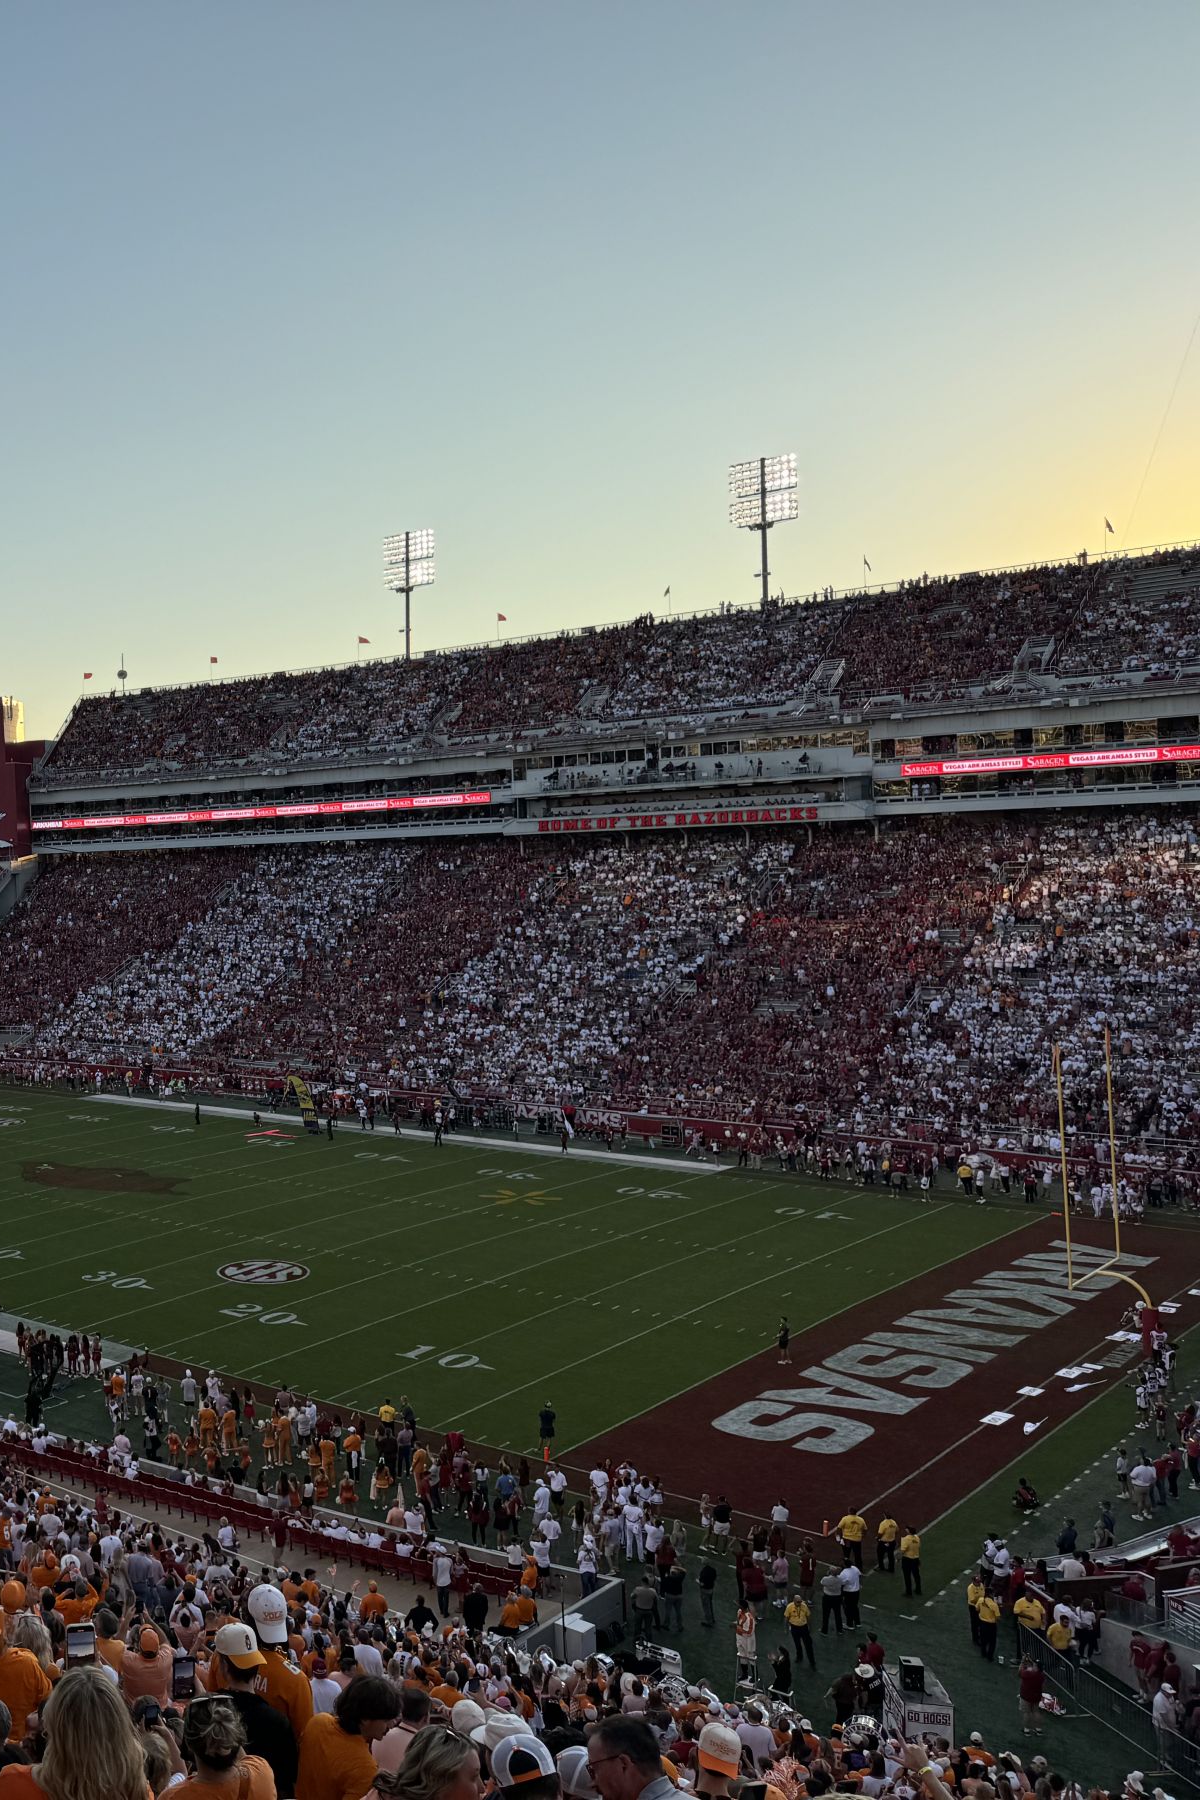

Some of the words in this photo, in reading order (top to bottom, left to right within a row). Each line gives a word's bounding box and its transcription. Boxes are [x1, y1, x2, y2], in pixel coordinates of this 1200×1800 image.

[538, 819, 592, 832] HOME
[596, 817, 621, 830] OF
[627, 815, 667, 828] THE
[674, 807, 818, 826] RAZORBACKS
[82, 1271, 145, 1290] 30
[218, 1302, 302, 1326] 20
[396, 1344, 485, 1370] 10
[711, 1240, 1160, 1454] ARKANSAS
[907, 1711, 920, 1722] GO
[923, 1712, 951, 1726] HOGS!
